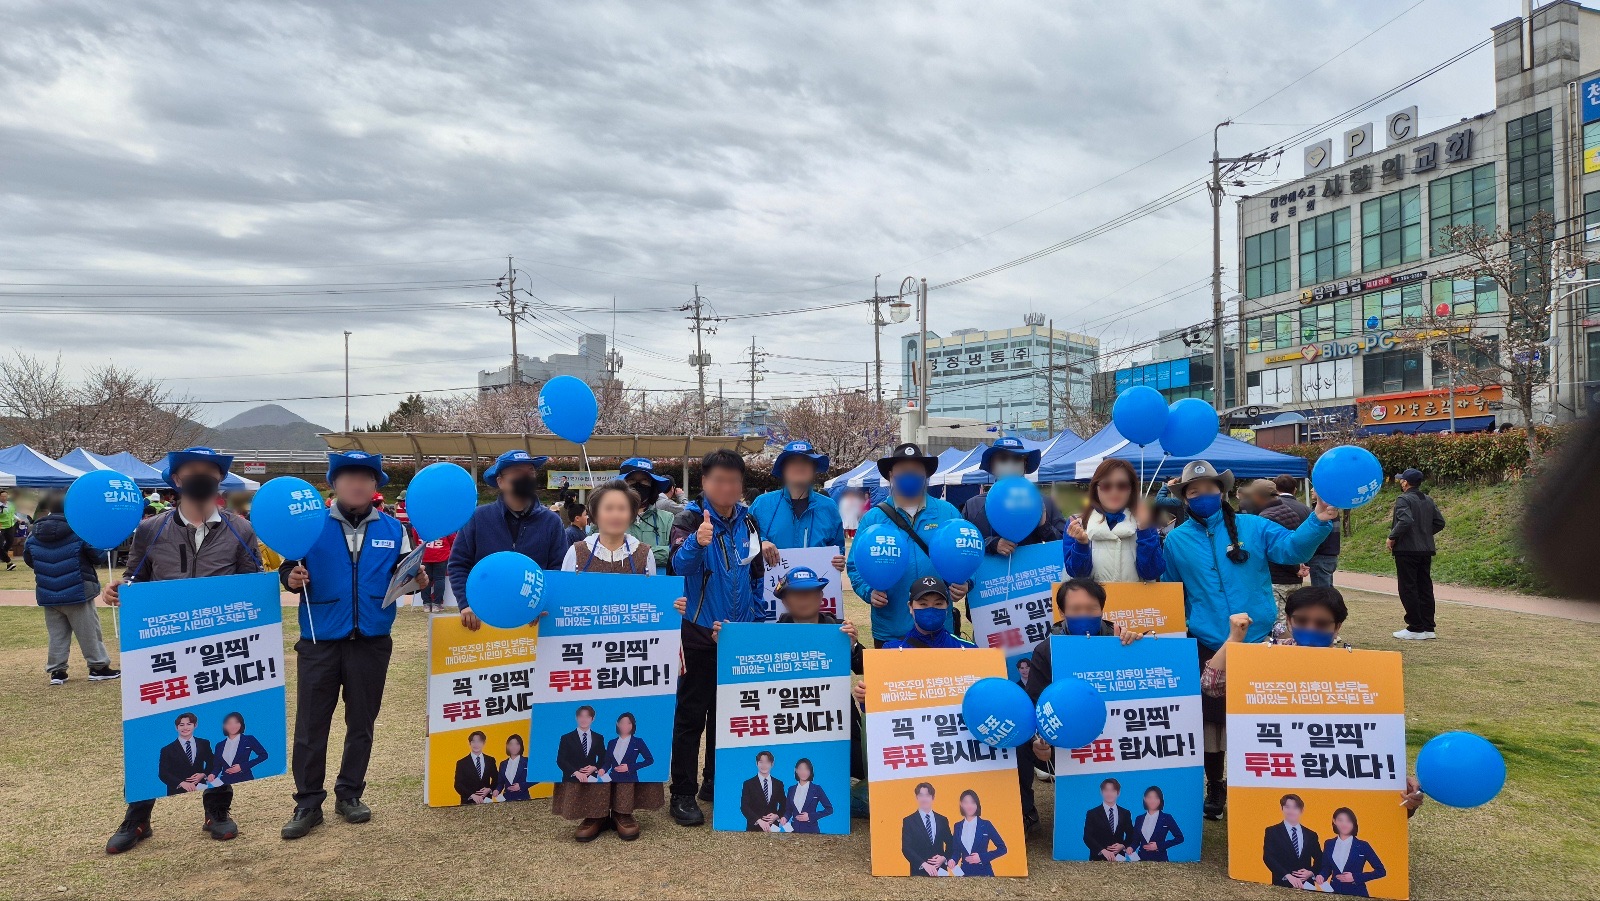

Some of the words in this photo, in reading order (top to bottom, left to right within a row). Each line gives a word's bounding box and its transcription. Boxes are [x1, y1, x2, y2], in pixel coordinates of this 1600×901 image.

[1270, 185, 1316, 208] 대한예수교
[1314, 278, 1361, 300] 당구클럽
[1321, 343, 1359, 358] Blue
[1364, 331, 1395, 352] PC
[108, 480, 134, 490] 투표
[1358, 478, 1378, 494] 투표
[103, 490, 140, 504] 합시다
[290, 489, 314, 500] 투표
[288, 499, 322, 515] 합시다
[876, 536, 896, 546] 투표
[960, 528, 979, 538] 투표
[870, 546, 902, 558] 합시다
[954, 538, 982, 550] 합시다
[1015, 570, 1037, 581] 최후의
[1039, 564, 1060, 576] 보루는
[520, 570, 536, 598] 투표
[528, 569, 544, 609] 합시다
[980, 587, 1009, 598] 깨어있는
[1012, 581, 1033, 591] 시민의
[1035, 576, 1056, 586] 조직된
[143, 612, 189, 627] "민주주의
[192, 606, 222, 619] 최후의
[224, 602, 253, 614] 보루는
[560, 606, 599, 616] "민주주의
[602, 604, 628, 615] 최후의
[631, 603, 657, 612] 보루는
[991, 608, 1011, 625] 꼭
[1110, 610, 1134, 620] 최후의
[1136, 608, 1160, 617] 보루는
[139, 625, 181, 639] 깨어있는
[184, 618, 214, 632] 시민의
[216, 612, 245, 625] 조직된
[248, 609, 261, 619] 힘"
[555, 617, 591, 627] 깨어있는
[594, 615, 620, 625] 시민의
[622, 614, 648, 624] 조직된
[651, 612, 663, 622] 힘"
[1130, 618, 1154, 628] 조직된
[1156, 616, 1167, 626] 힘"
[151, 652, 176, 673] 꼭
[186, 634, 260, 666] "일찍"
[446, 654, 477, 665] 깨어있는
[480, 650, 502, 660] 시민의
[505, 647, 527, 657] 조직된
[449, 644, 484, 655] "민주주의
[486, 640, 508, 650] 최후의
[562, 643, 583, 664] 꼭
[592, 638, 659, 663] "일찍"
[732, 666, 765, 675] 깨어있는
[768, 663, 792, 672] 시민의
[794, 661, 818, 671] 조직된
[821, 659, 832, 669] 힘"
[736, 654, 772, 665] "민주주의
[775, 652, 799, 662] 최후의
[801, 651, 826, 660] 보루는
[549, 669, 592, 692] 투표
[1116, 669, 1143, 680] 최후의
[1145, 667, 1172, 677] 보루는
[140, 676, 190, 704] 투표
[453, 677, 472, 696] 꼭
[884, 680, 924, 692] "민주주의
[927, 677, 952, 689] 최후의
[1109, 680, 1136, 692] 시민의
[1139, 678, 1165, 689] 조직된
[1168, 677, 1180, 688] 힘"
[1250, 682, 1296, 692] "민주주의
[1300, 682, 1332, 692] 최후의
[1335, 682, 1368, 692] 보루는
[740, 690, 760, 711] 꼭
[768, 684, 830, 708] "일찍"
[882, 691, 917, 702] 깨어있는
[920, 687, 946, 698] 시민의
[1246, 694, 1288, 704] 깨어있는
[1292, 694, 1323, 704] 시민의
[1326, 694, 1359, 704] 조직된
[1363, 693, 1378, 704] 힘"
[443, 699, 481, 722] 투표
[1042, 701, 1064, 731] 투표
[1111, 705, 1180, 732] "일찍"
[730, 715, 769, 737] 투표
[892, 718, 914, 740] 꼭
[977, 714, 1000, 735] 투표
[984, 719, 1016, 745] 합시다
[1257, 723, 1282, 747] 꼭
[1292, 722, 1376, 748] "일찍"
[883, 744, 928, 770] 투표
[1245, 753, 1297, 777] 투표
